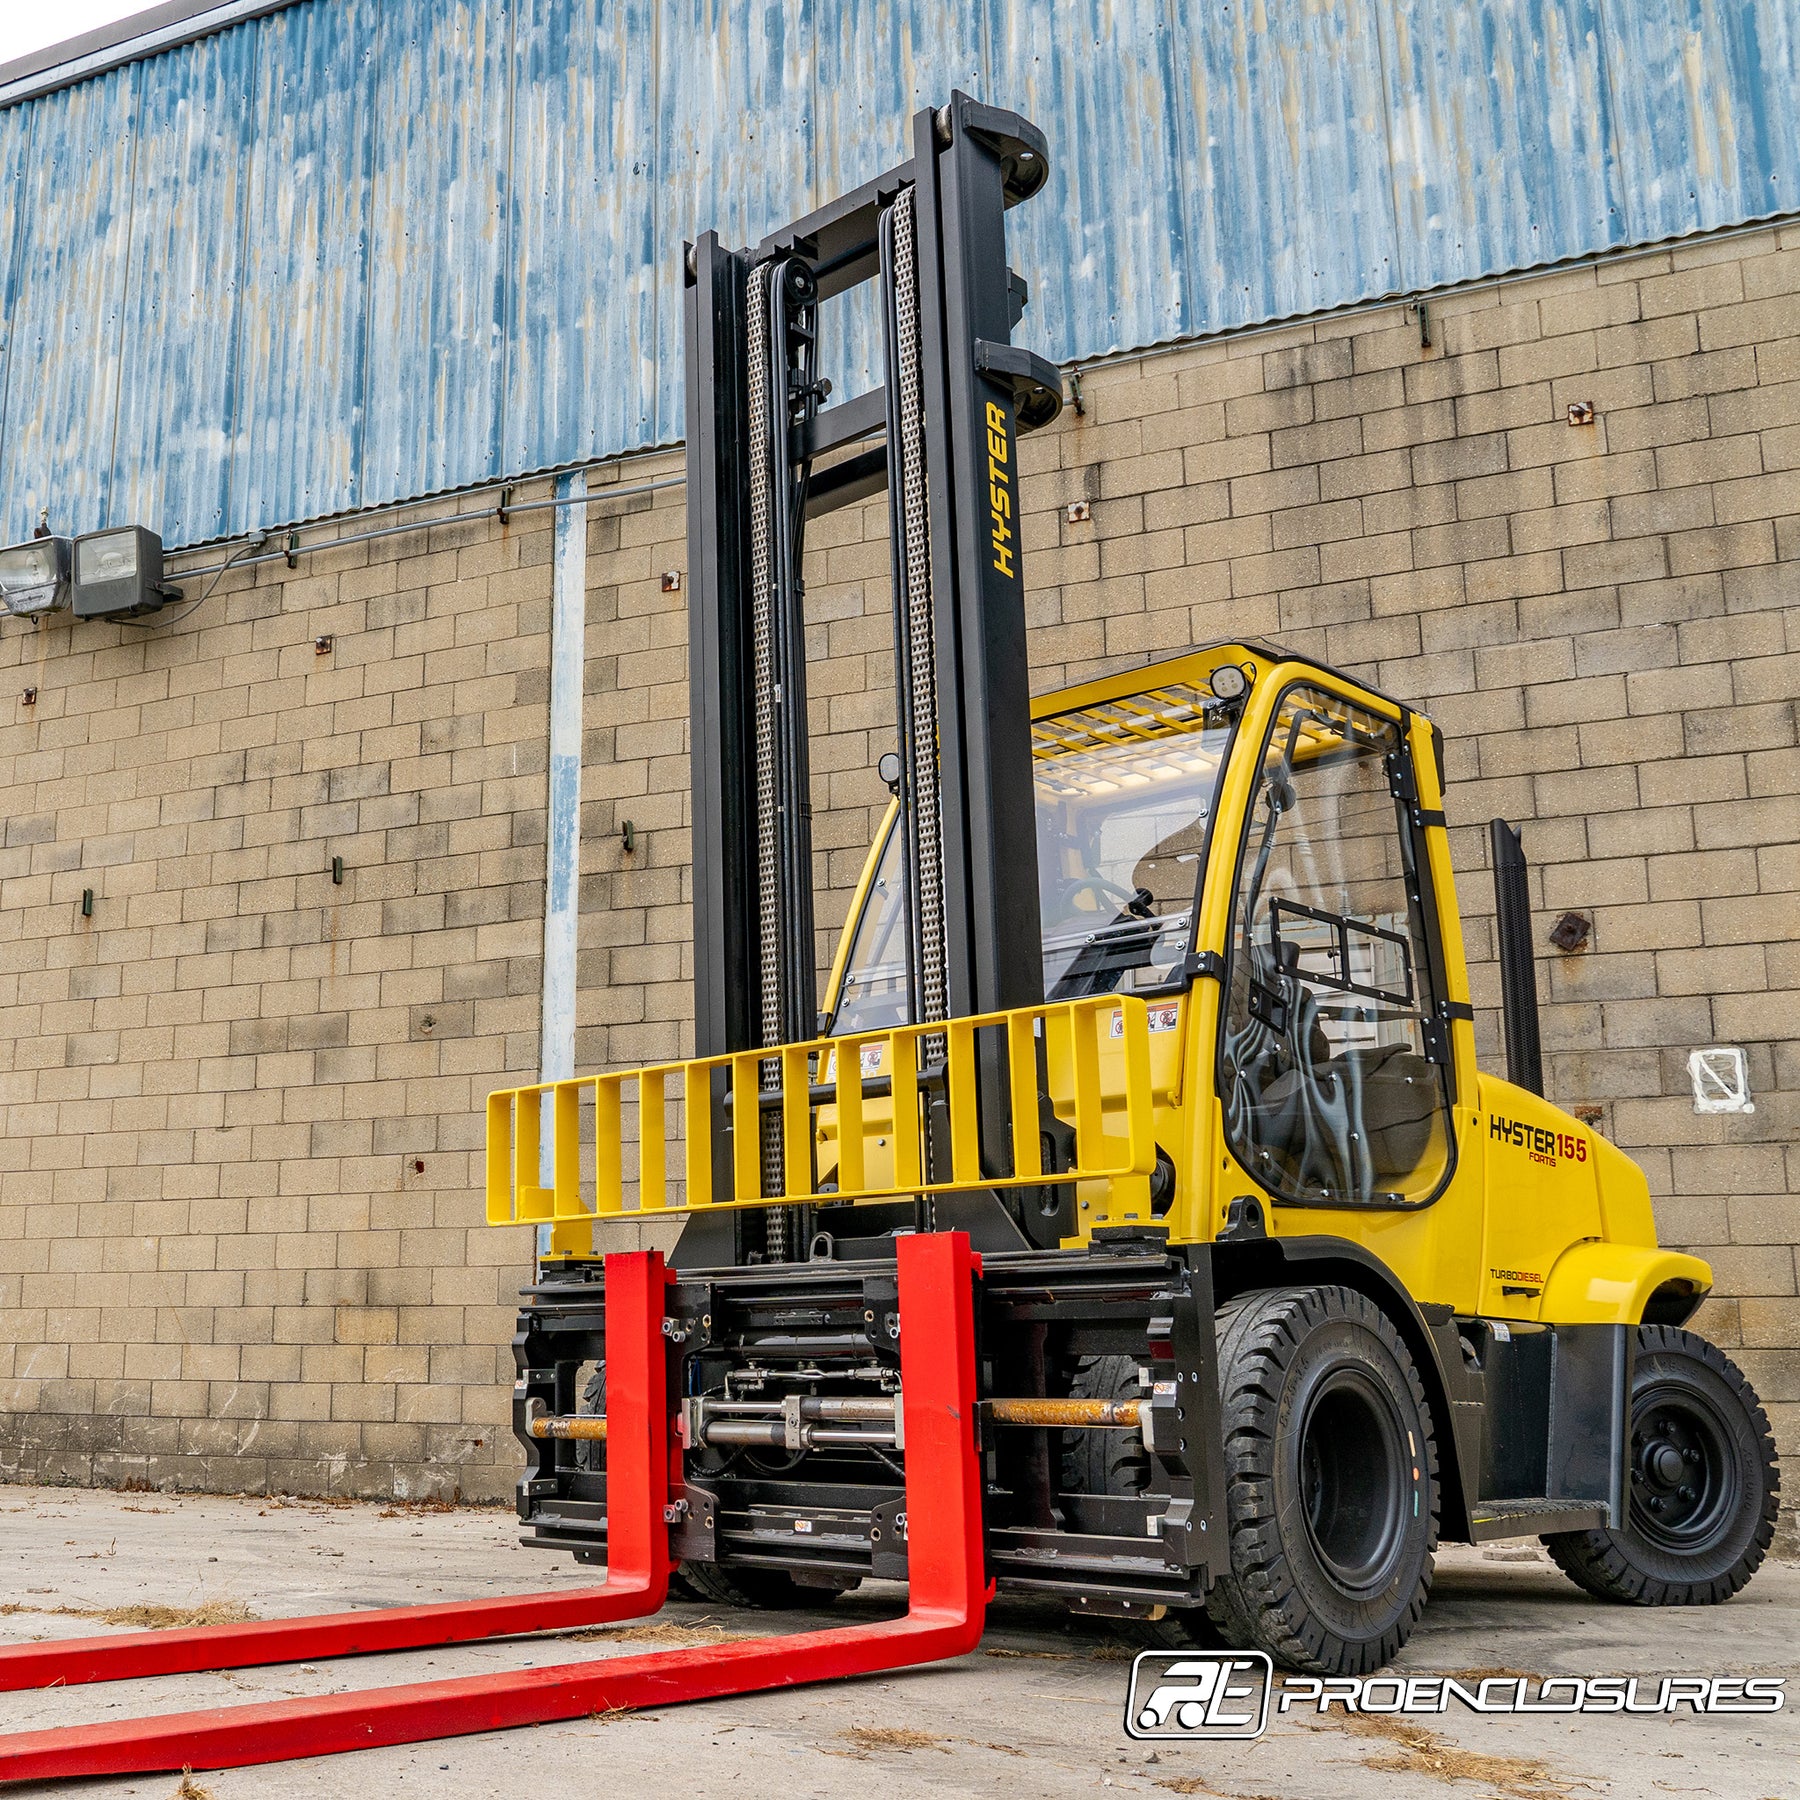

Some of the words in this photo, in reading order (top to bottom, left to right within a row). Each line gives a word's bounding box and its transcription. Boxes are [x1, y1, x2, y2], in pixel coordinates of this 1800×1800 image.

[985, 401, 1014, 579] HYSTER
[1490, 1113, 1555, 1156] HYSTER
[1557, 1133, 1587, 1163] 155
[1529, 1151, 1557, 1168] FORTIS
[1489, 1268, 1544, 1284] TURBODIESEL
